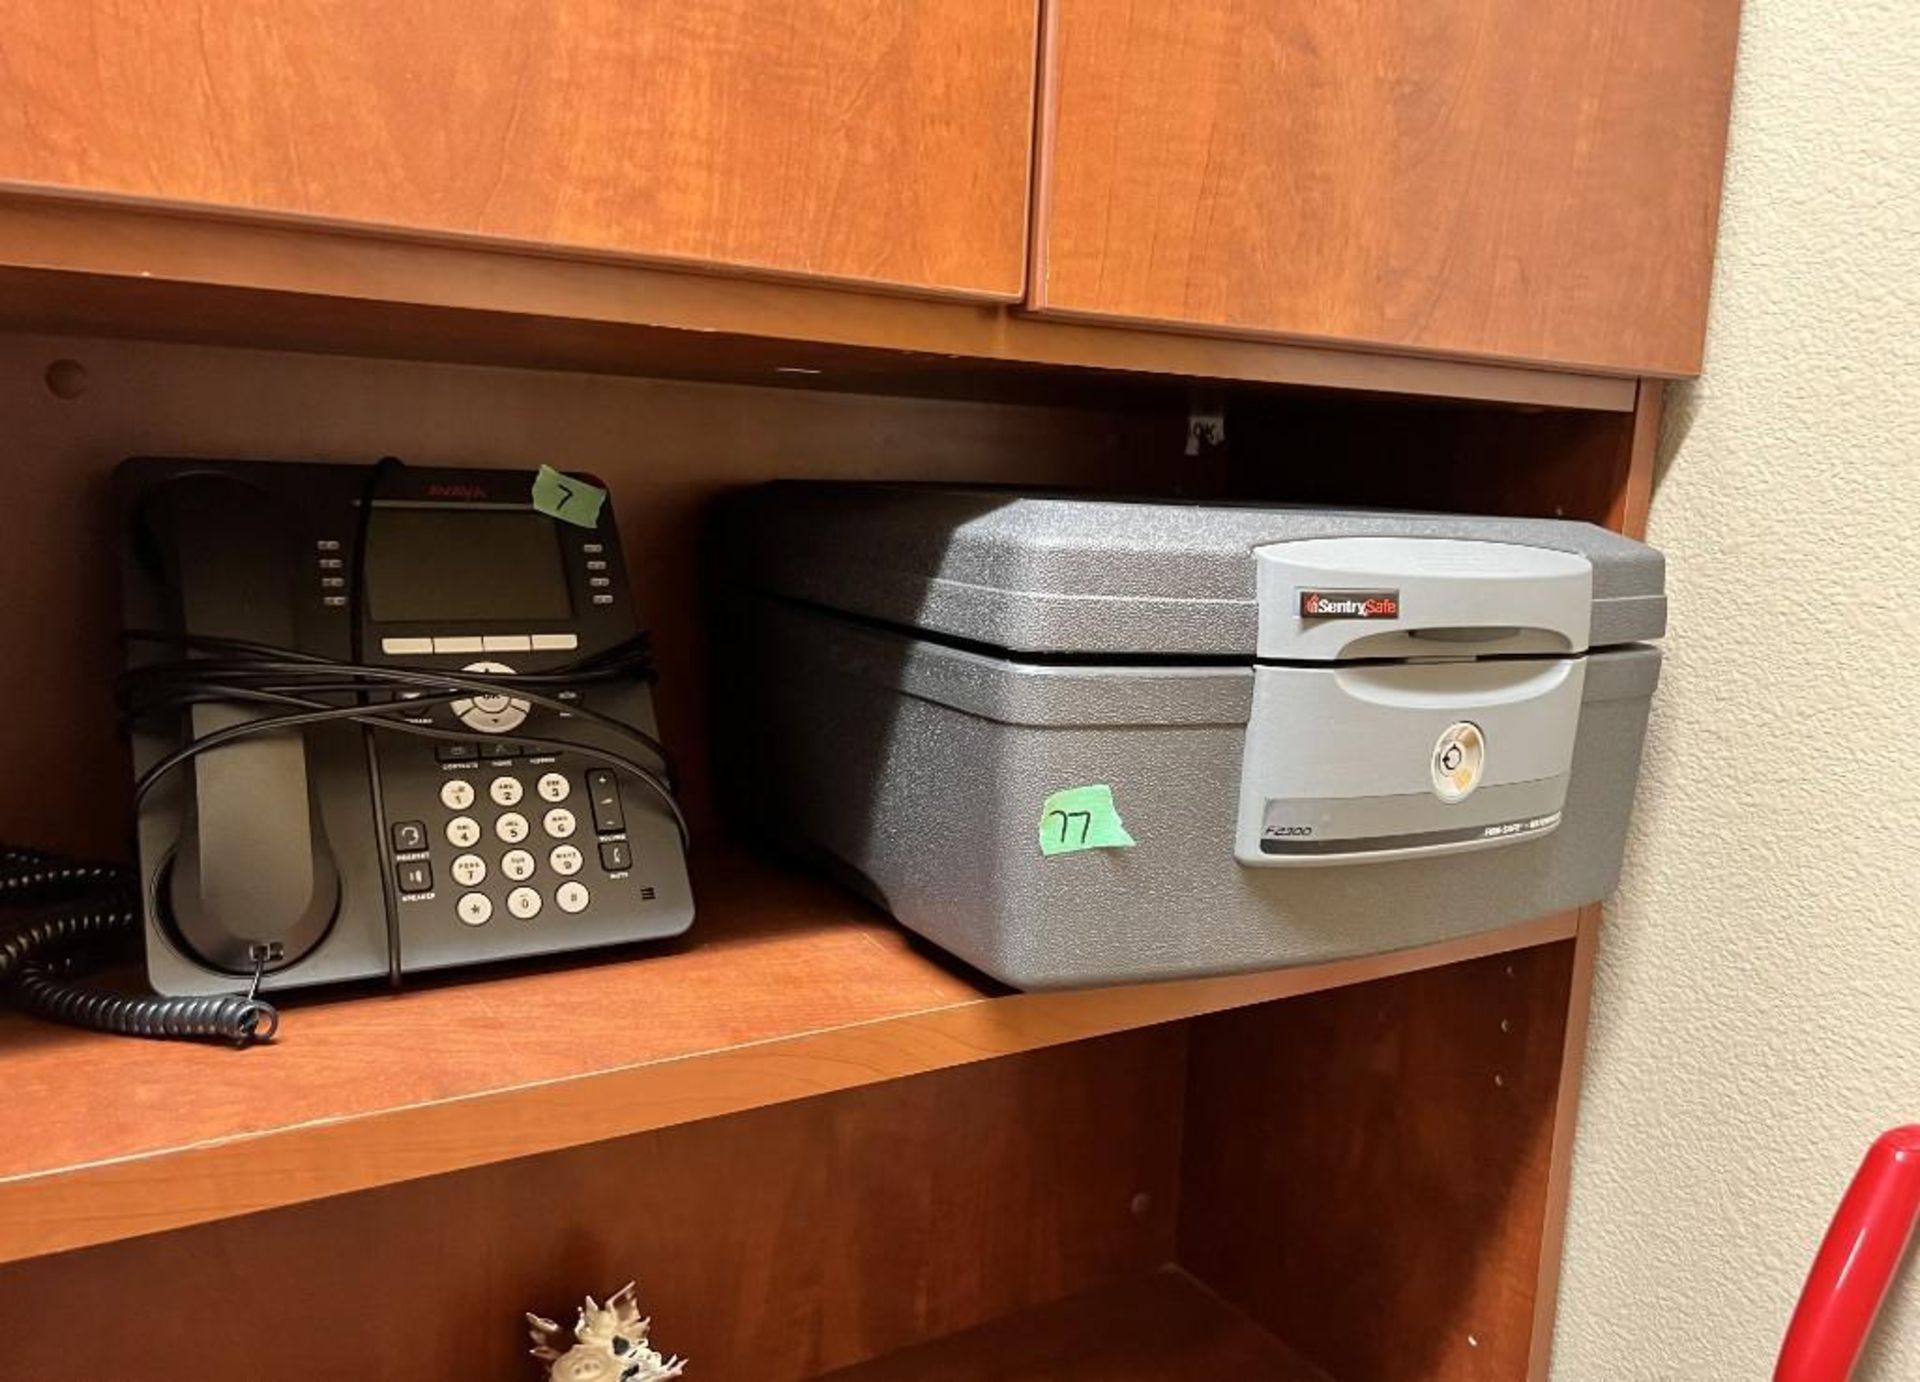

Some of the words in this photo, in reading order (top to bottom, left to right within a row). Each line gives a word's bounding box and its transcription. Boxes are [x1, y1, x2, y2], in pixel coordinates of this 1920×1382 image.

[557, 484, 573, 510] 7
[1318, 598, 1397, 617] SentrySafe
[504, 791, 512, 800] 2
[558, 824, 565, 832] 6
[1049, 810, 1091, 843] 77
[460, 832, 468, 842] 4
[510, 829, 518, 838] 5
[563, 861, 572, 869] 9
[516, 866, 523, 875] 8
